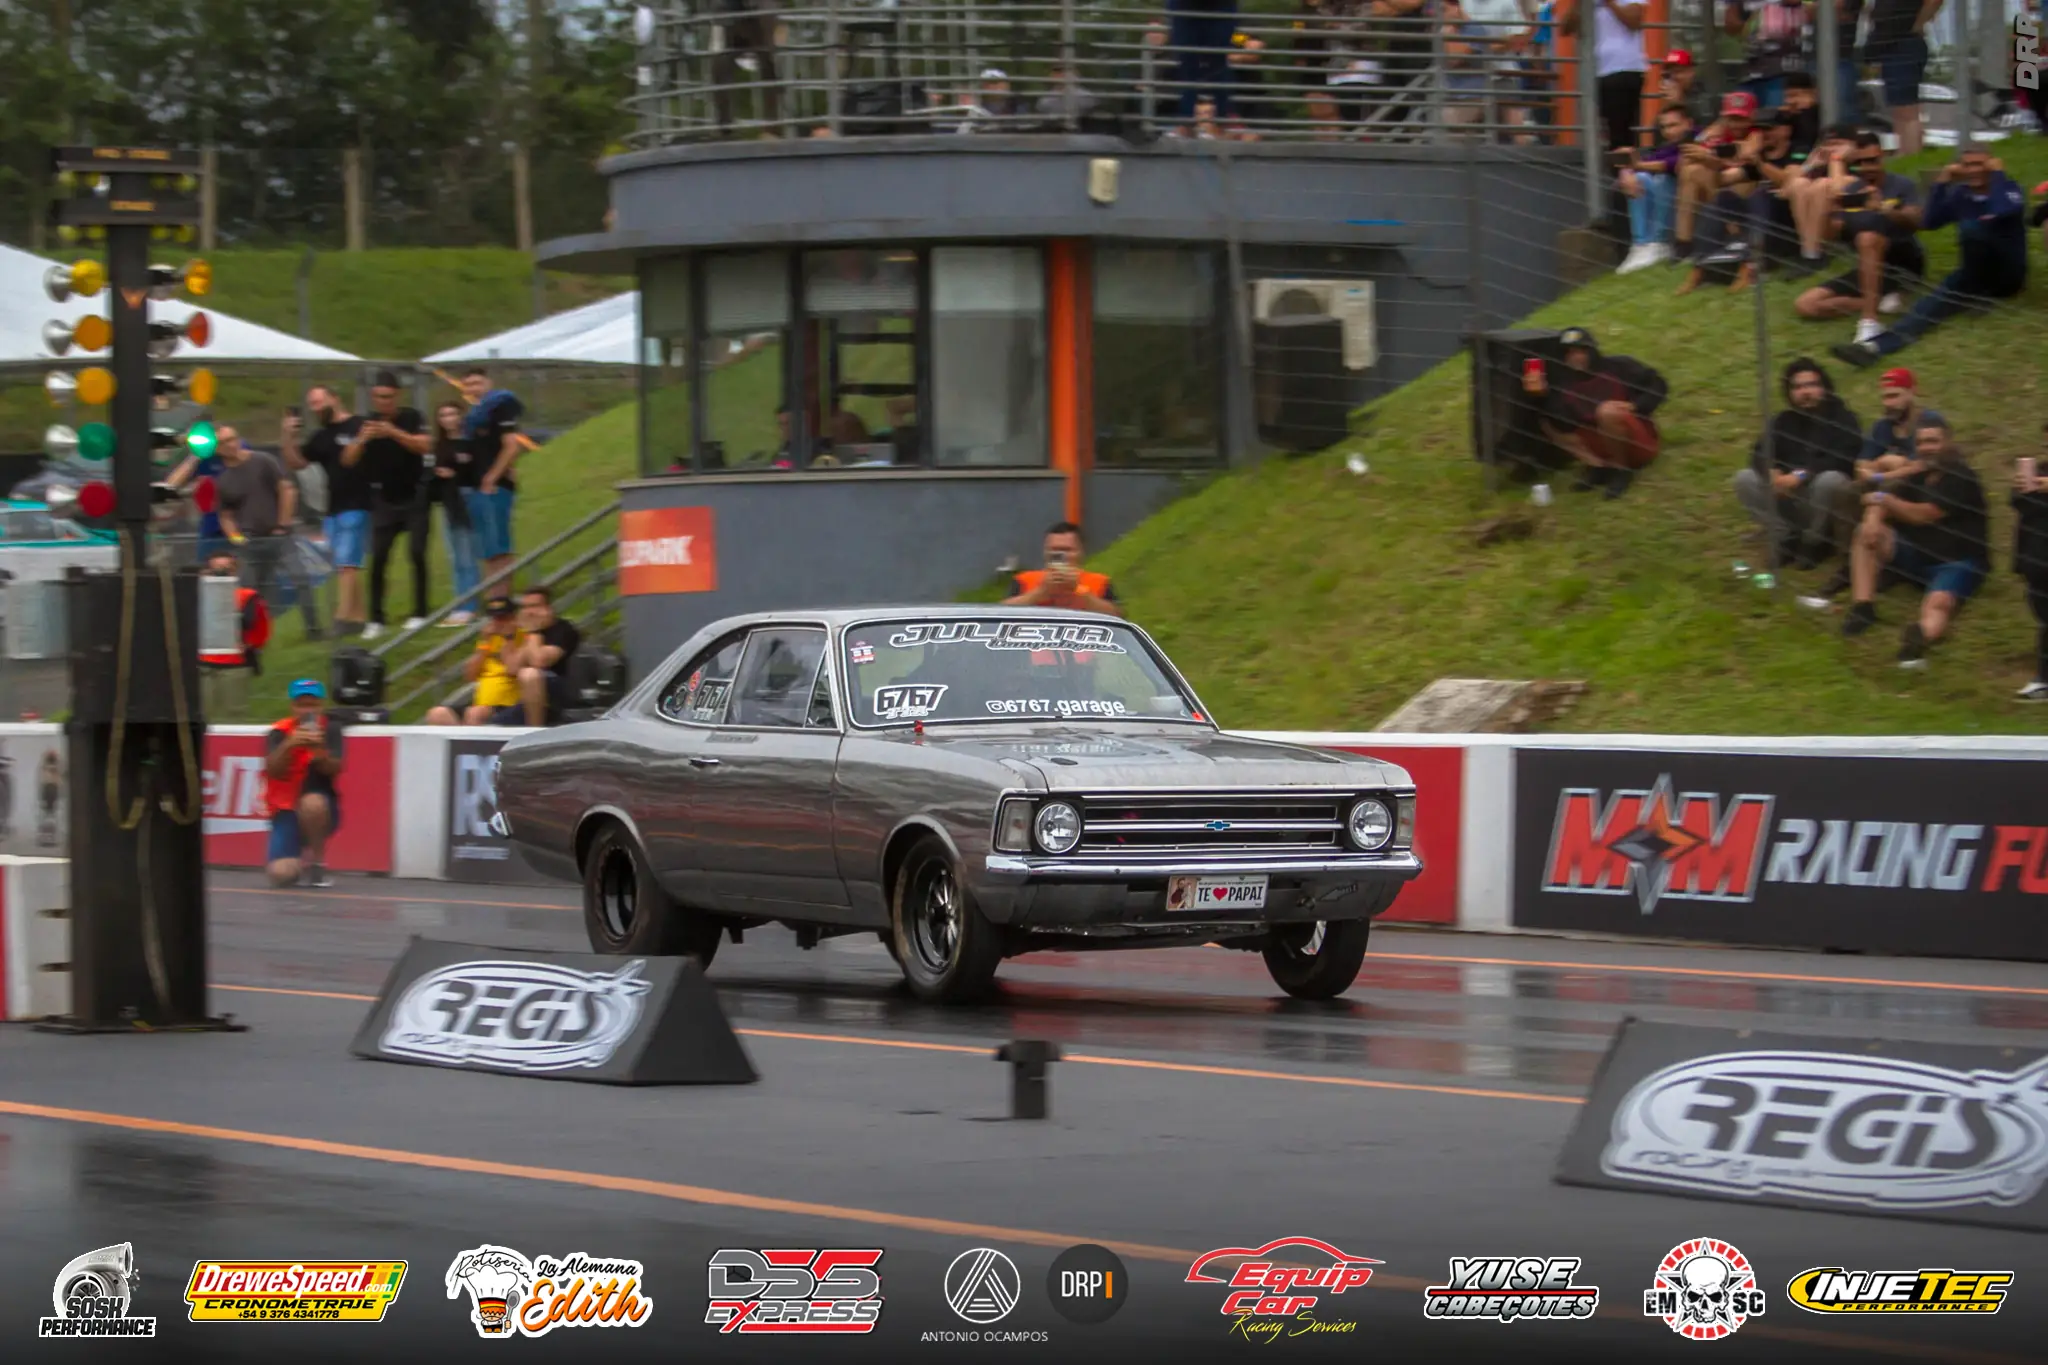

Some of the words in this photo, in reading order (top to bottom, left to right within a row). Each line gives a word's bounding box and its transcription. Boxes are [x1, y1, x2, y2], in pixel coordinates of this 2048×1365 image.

[889, 623, 1114, 647] JULIETA
[876, 686, 946, 714] 6767
[1008, 698, 1126, 716] 6767.garage
[1765, 819, 1984, 891] RACING
[1198, 886, 1211, 902] TE
[1227, 886, 1264, 902] PAPAI
